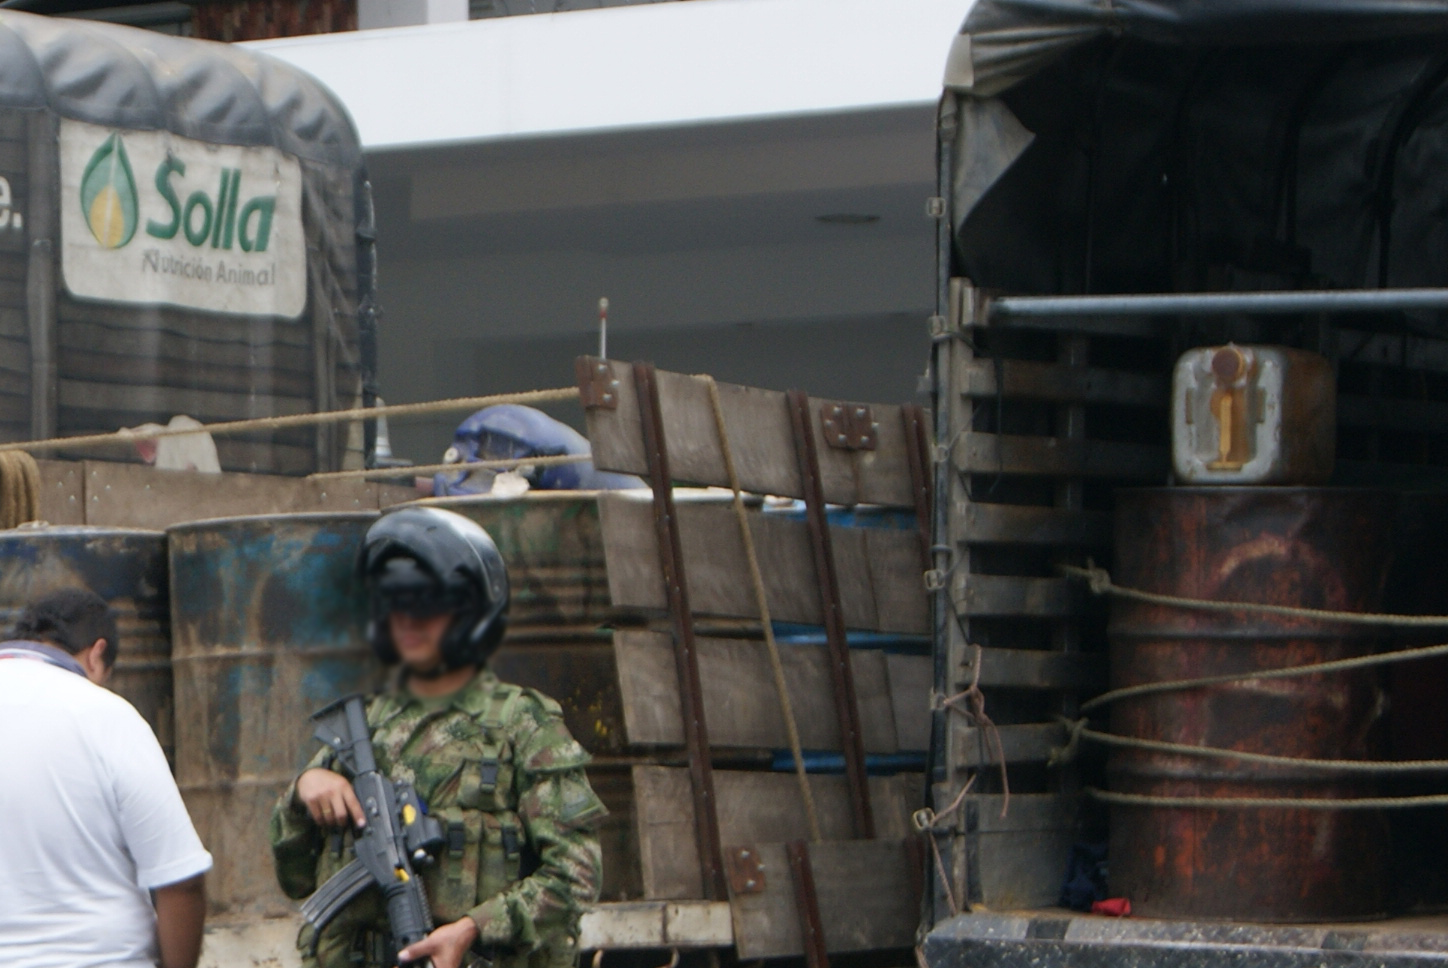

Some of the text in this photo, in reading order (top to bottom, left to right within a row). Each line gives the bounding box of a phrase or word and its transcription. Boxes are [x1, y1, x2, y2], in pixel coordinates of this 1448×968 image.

[146, 157, 277, 252] Solla
[142, 250, 276, 286] Nutrición Animal
